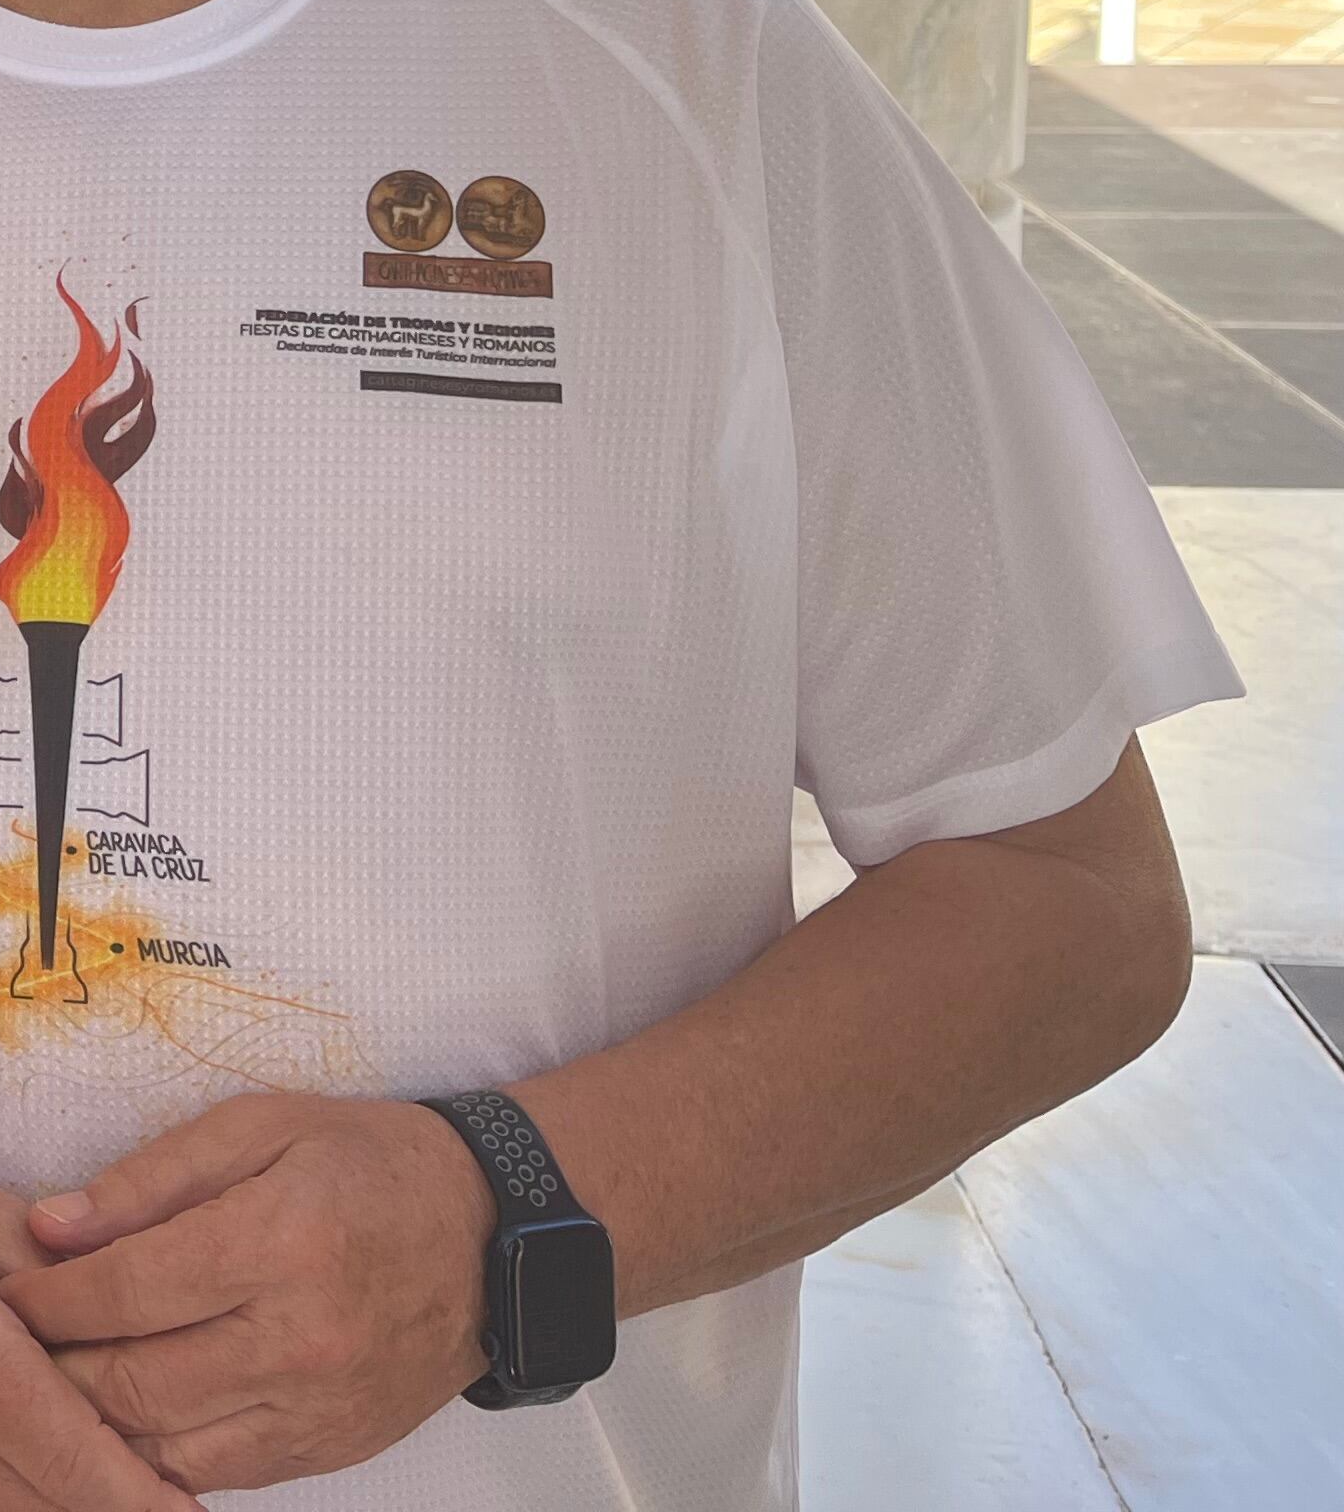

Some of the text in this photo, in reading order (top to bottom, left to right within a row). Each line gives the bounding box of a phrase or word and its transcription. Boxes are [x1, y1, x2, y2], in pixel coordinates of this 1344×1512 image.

[255, 309, 555, 338] FEDERACIÓN DE TROPAS Y LEGIONES
[240, 323, 556, 354] FIESTAS DE CARTHAGINESES Y ROMANOS
[276, 340, 557, 369] Declaradas de Interés Turístico Internacional
[86, 830, 187, 856] CARAVACA
[88, 852, 210, 882] DE LA CRUZ
[136, 937, 231, 969] MURCIA
